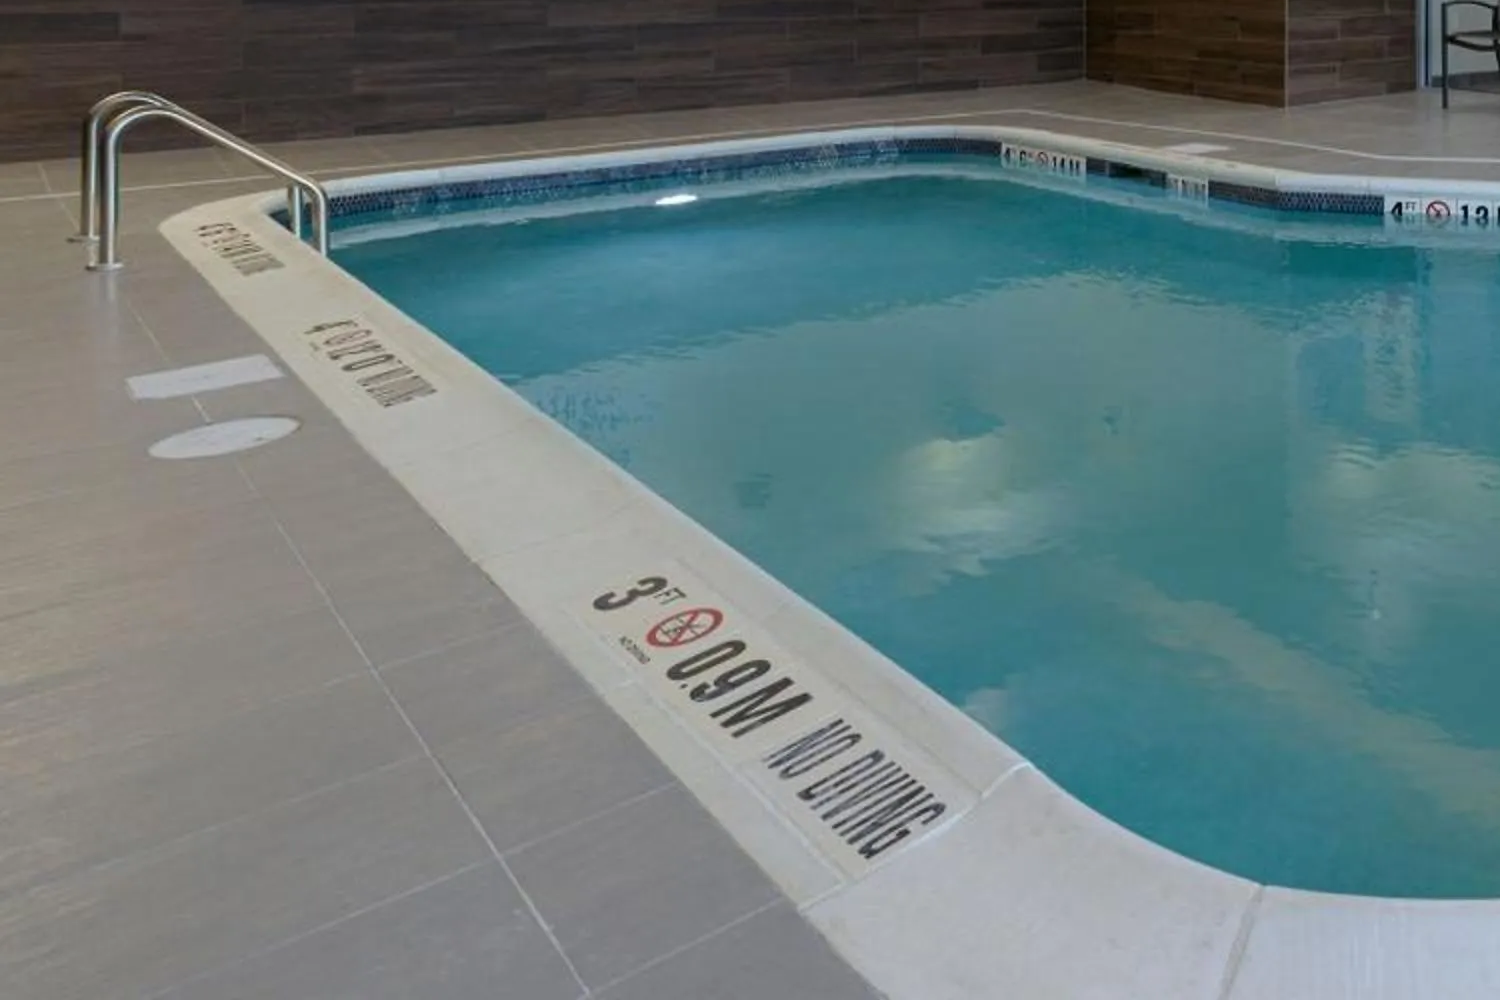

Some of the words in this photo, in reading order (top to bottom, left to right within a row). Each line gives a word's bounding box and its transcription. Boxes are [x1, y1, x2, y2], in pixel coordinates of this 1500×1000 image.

[666, 639, 813, 739] 0.9M
[762, 718, 862, 780] NO
[797, 749, 947, 860] DIVING
